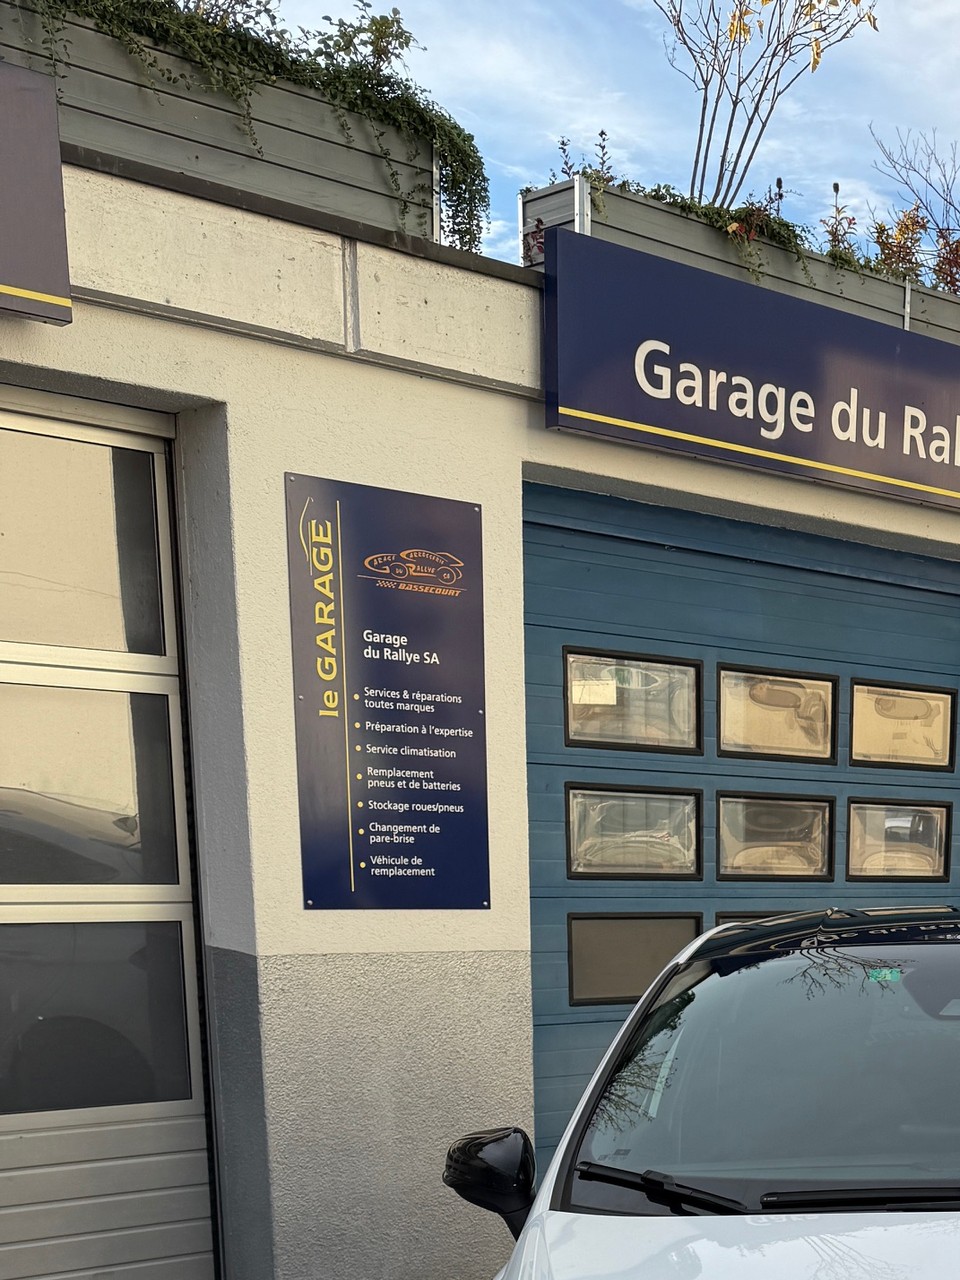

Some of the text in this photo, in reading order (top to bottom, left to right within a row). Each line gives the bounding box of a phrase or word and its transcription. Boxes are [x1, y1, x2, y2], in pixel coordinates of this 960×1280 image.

[634, 339, 816, 440] Garage
[831, 387, 887, 449] du
[398, 583, 462, 597] BASSECOURT
[311, 519, 339, 717] le GARAGE
[363, 630, 408, 647] Garage
[363, 645, 440, 665] du Rallye SA
[364, 686, 462, 703] Services & réparations
[364, 699, 435, 714] toutes marques
[365, 721, 473, 738] Préparation à l'expertise
[366, 743, 456, 758] Service climatisation
[367, 766, 434, 779] Remplacement
[367, 779, 461, 791] pneus et de batteries
[368, 800, 464, 813] Stockage roues/pneus
[369, 822, 440, 834] Changement de
[369, 833, 415, 844] pare-brise
[370, 855, 422, 865] Véhicule de
[371, 867, 435, 878] remplacement
